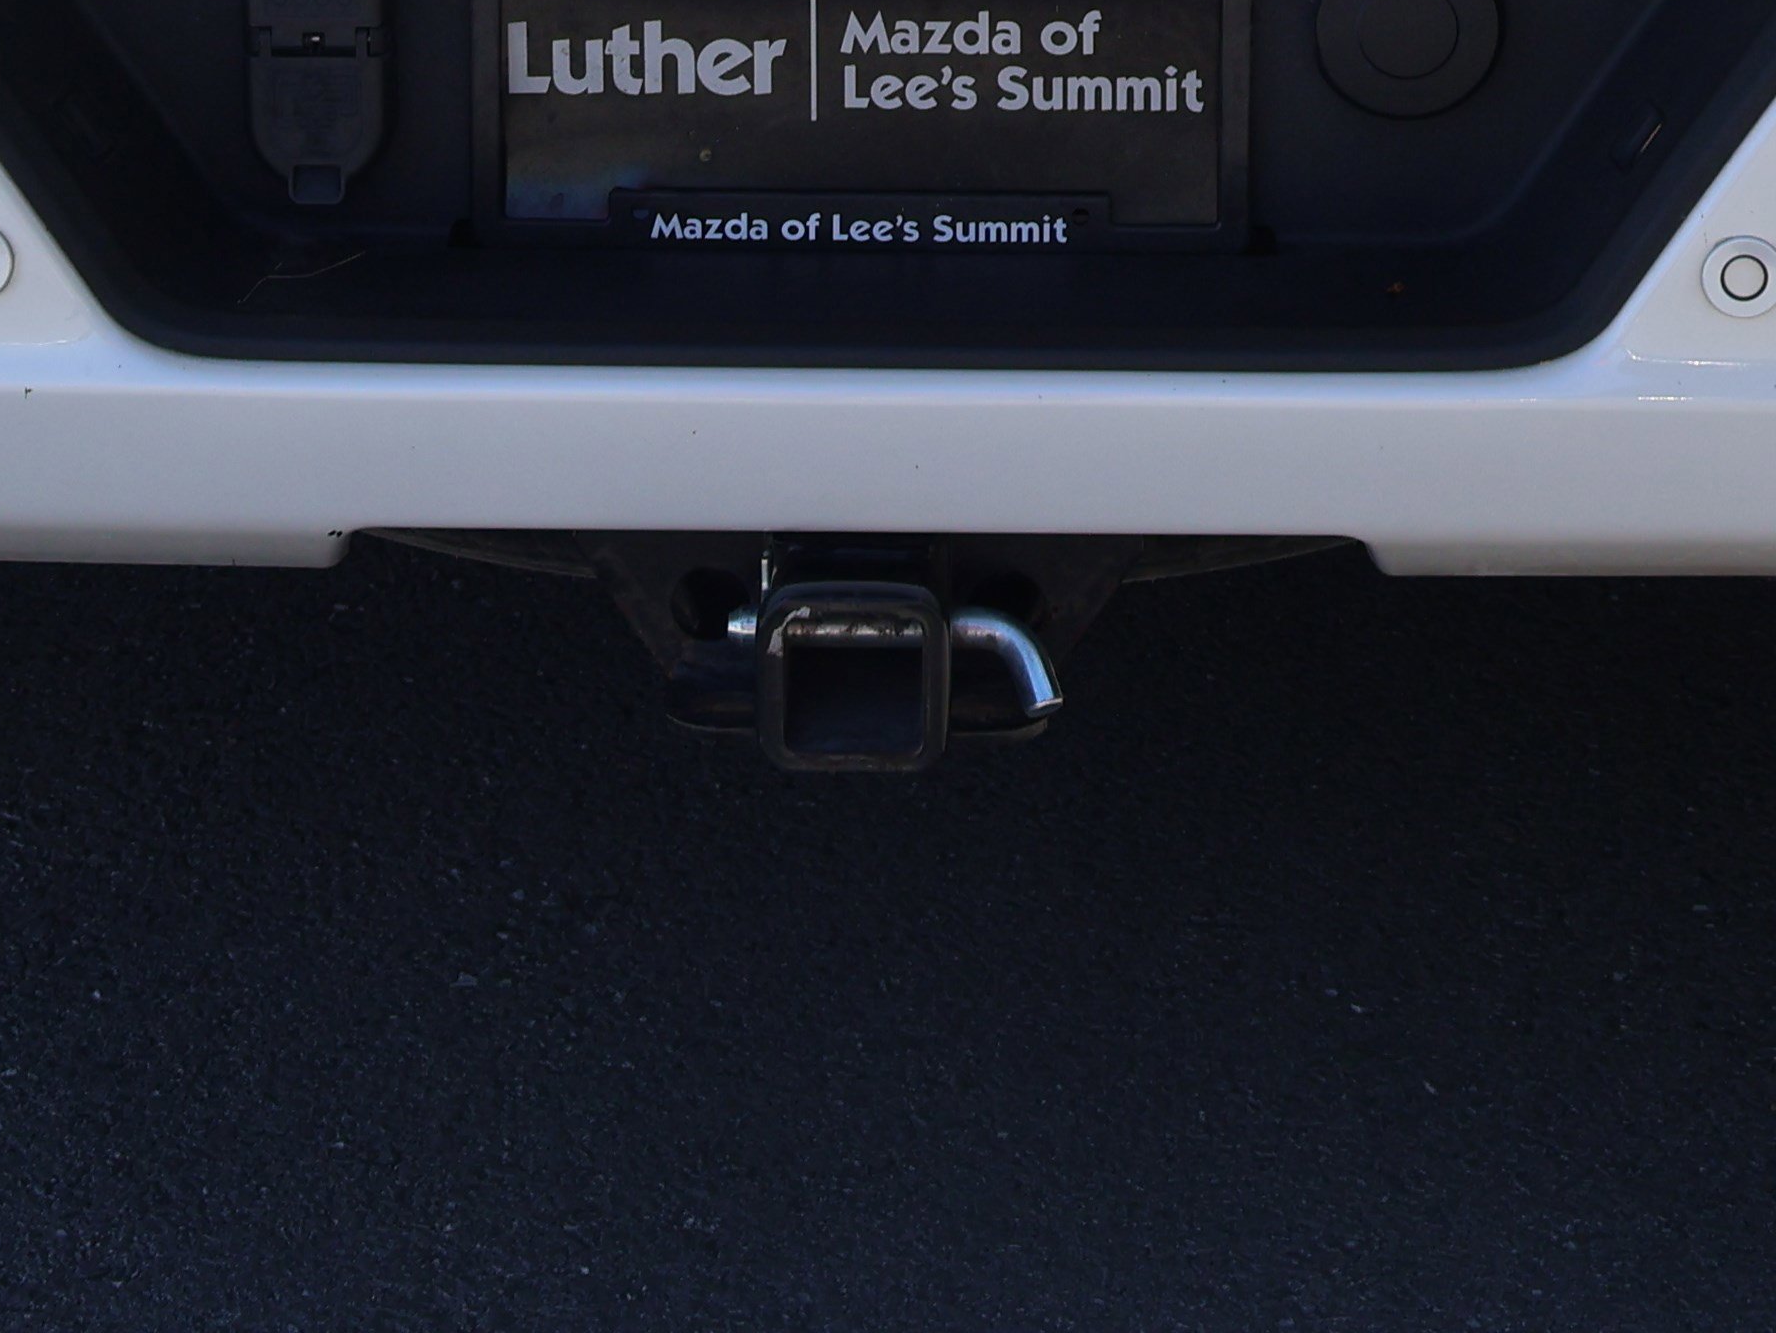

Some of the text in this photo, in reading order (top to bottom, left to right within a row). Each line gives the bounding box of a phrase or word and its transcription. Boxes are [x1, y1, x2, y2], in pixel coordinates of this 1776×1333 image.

[841, 11, 1101, 55] Mazda of
[508, 20, 786, 95] Luther
[845, 65, 1203, 112] Lee's Summit
[652, 213, 1067, 242] Mazda of Lee's Summit
